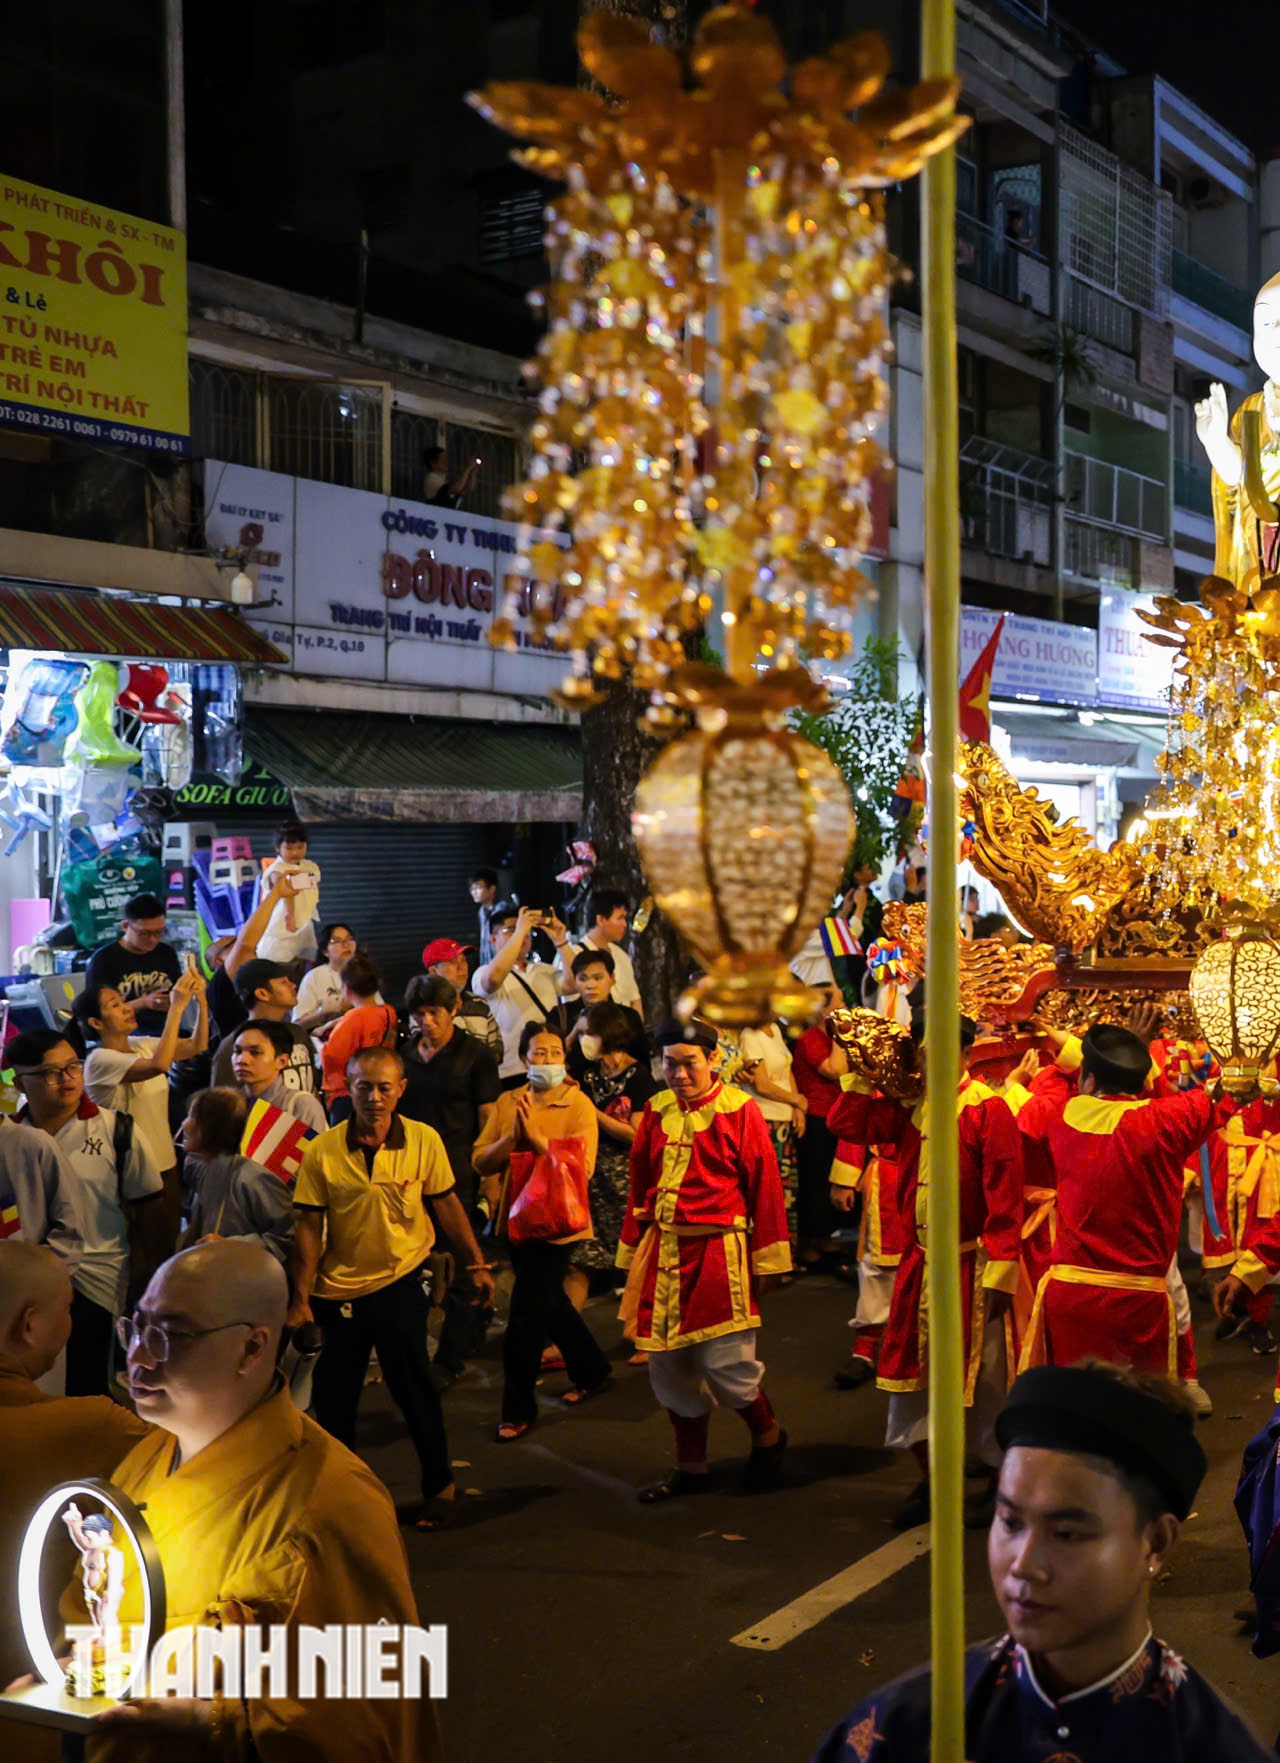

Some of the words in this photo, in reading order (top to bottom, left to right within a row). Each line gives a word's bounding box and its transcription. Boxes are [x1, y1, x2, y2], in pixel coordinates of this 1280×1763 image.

[4, 187, 50, 213] PHÁT
[105, 219, 117, 234] &
[121, 223, 140, 240] SX
[152, 232, 175, 251] TM
[6, 286, 20, 304] &
[25, 291, 47, 311] Lẻ
[3, 314, 37, 339] TỦ
[45, 323, 118, 359] NHỰA
[50, 354, 87, 379] EM
[37, 379, 83, 407] NỘI
[88, 391, 150, 419] THẤT
[17, 408, 40, 426] 028
[43, 414, 71, 432] 2261
[74, 421, 101, 437] 0061
[110, 427, 138, 444] 0979
[139, 434, 153, 447] 61
[170, 439, 184, 453] 61
[382, 508, 439, 539] CÔNG
[444, 523, 468, 545] TY
[330, 603, 385, 630] TRANG
[389, 611, 412, 633] TRÍ
[415, 613, 443, 639] NỘI
[340, 639, 365, 654] Q.10
[176, 783, 233, 805] SOFA
